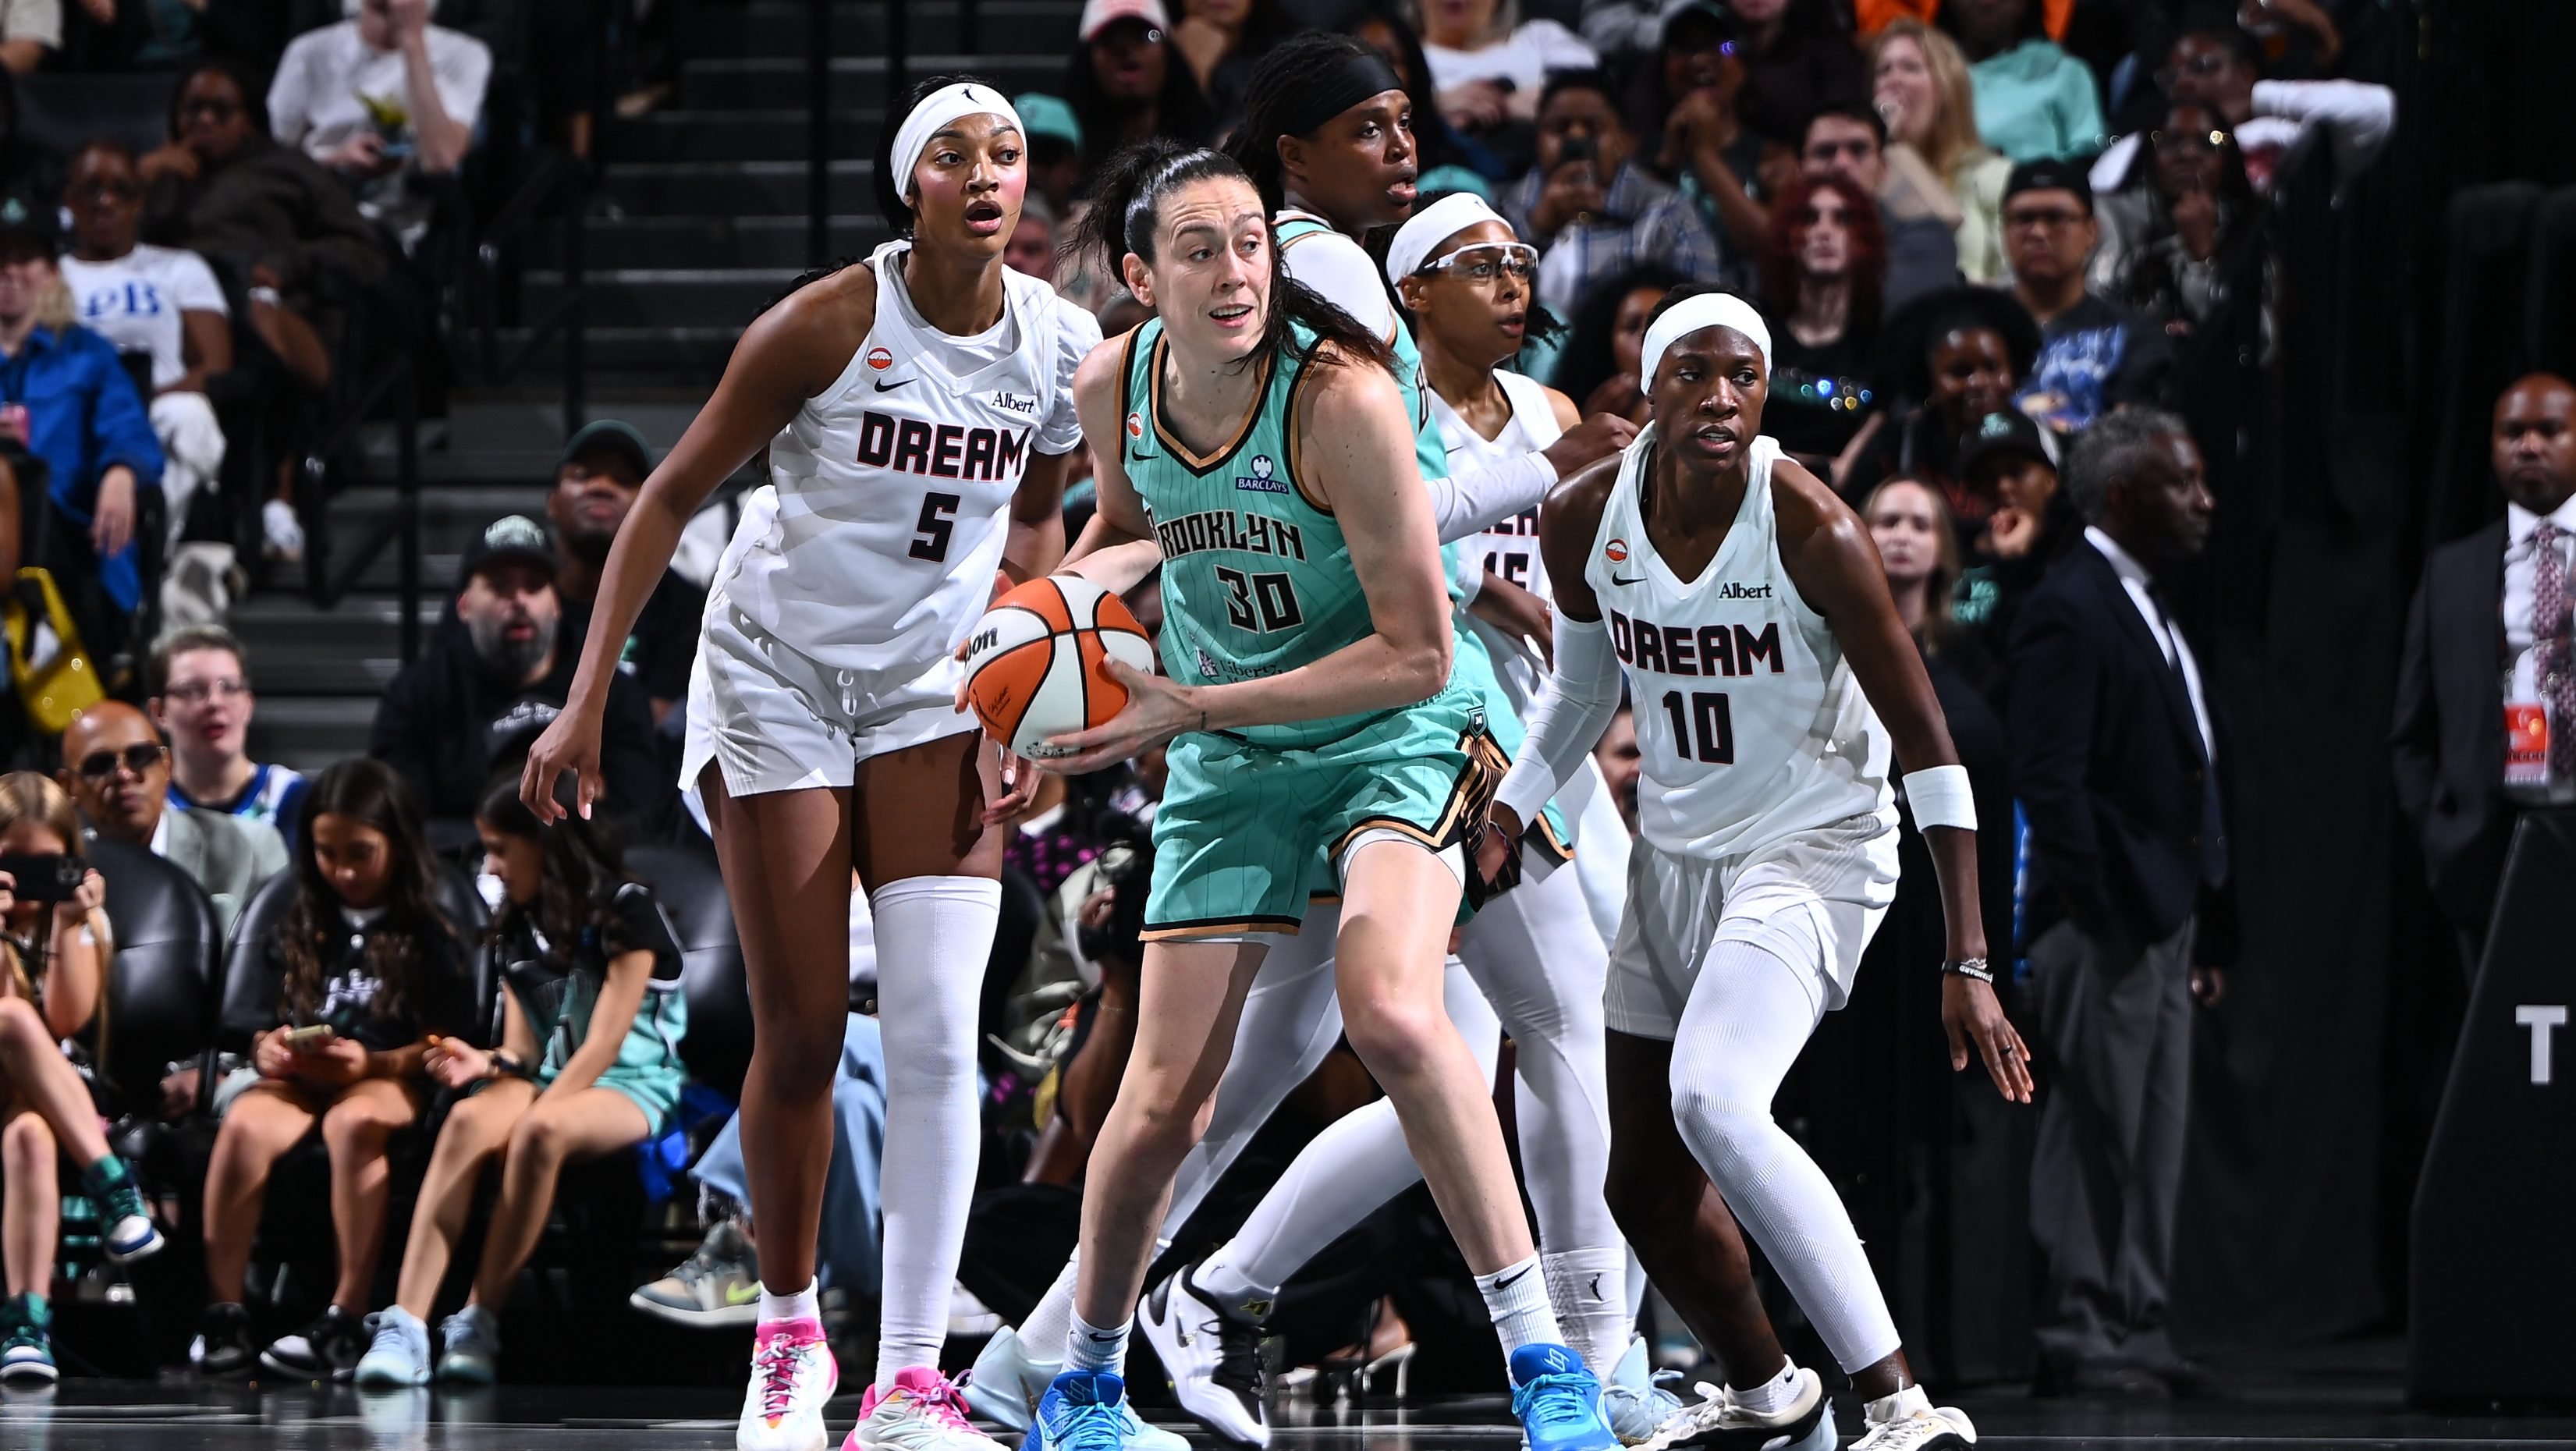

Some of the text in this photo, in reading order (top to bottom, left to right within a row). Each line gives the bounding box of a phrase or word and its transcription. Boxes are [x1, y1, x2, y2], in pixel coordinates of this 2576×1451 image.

[991, 390, 1034, 413] Albert
[856, 410, 1033, 482] DREAM
[1237, 478, 1288, 493] BARCLAYS
[907, 491, 961, 562] 5
[1214, 564, 1304, 633] 30
[1718, 582, 1772, 599] Albert
[1610, 607, 1786, 677] DREAM
[1662, 690, 1735, 765] 10
